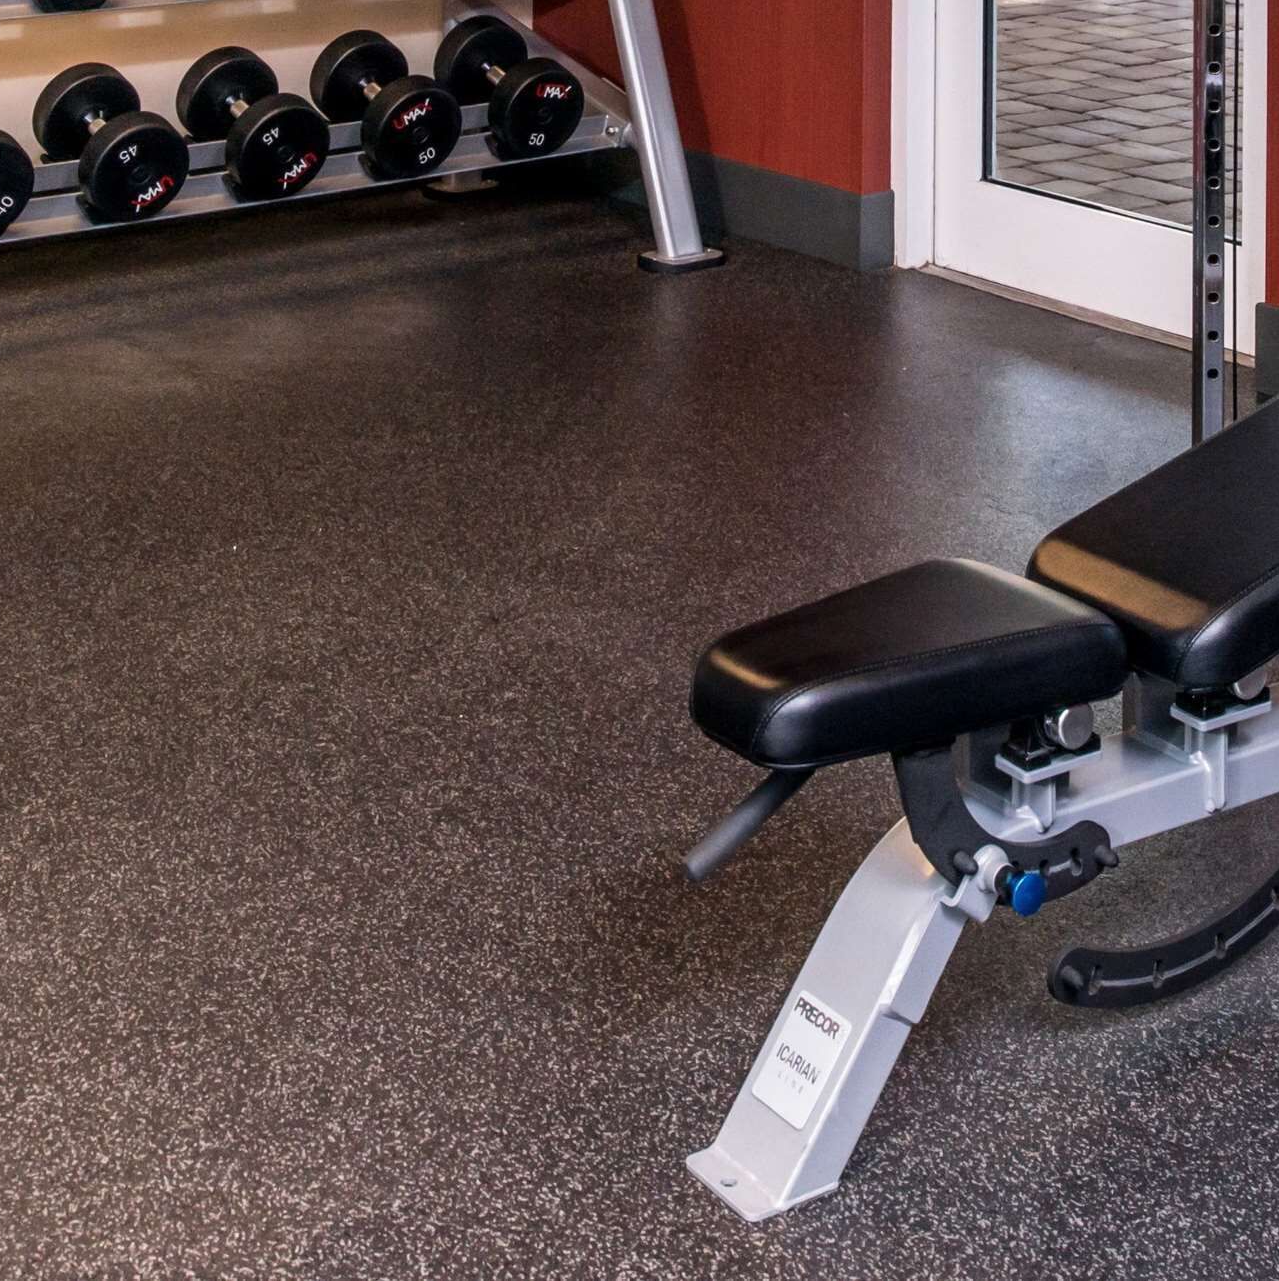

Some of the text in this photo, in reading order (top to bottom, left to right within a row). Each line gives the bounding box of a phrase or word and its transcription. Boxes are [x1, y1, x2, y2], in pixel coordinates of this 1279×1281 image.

[536, 82, 572, 100] UMAX
[391, 97, 432, 132] UMAX
[262, 126, 280, 146] 45
[528, 133, 545, 146] 50
[119, 143, 138, 164] 45
[418, 147, 436, 164] 50
[278, 151, 318, 190] UMAX
[131, 174, 175, 213] UMAX
[793, 997, 840, 1040] PRECOR
[776, 1042, 818, 1085] ICARIAN
